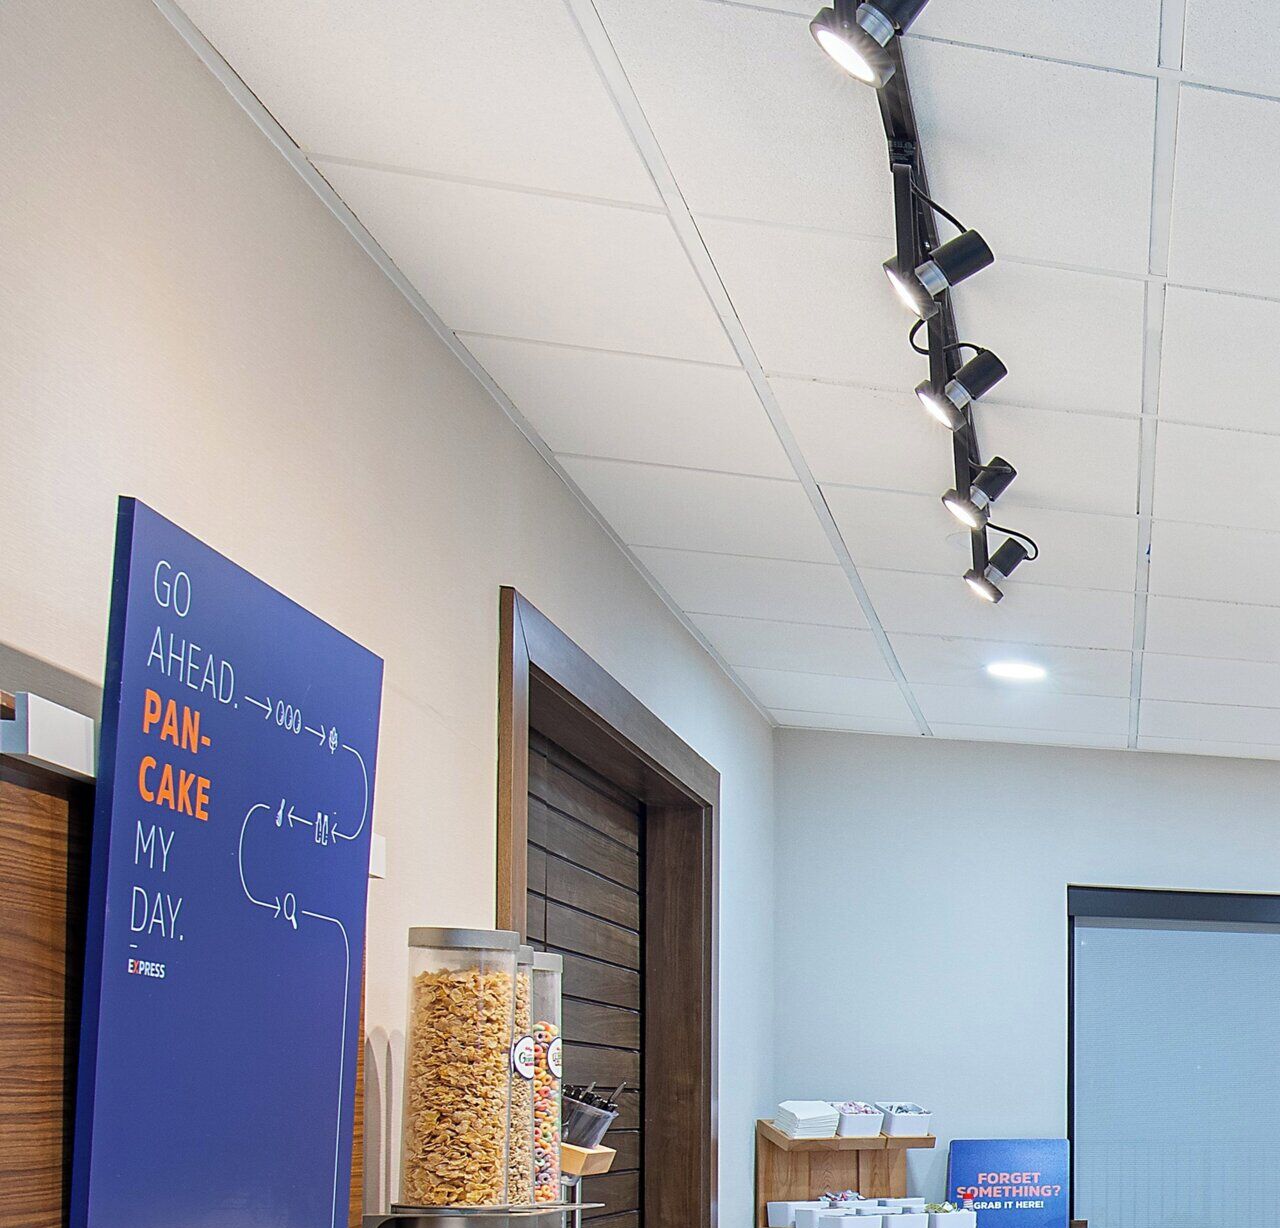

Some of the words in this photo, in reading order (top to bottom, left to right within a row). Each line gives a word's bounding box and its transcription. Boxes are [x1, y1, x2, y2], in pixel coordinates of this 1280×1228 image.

[154, 560, 191, 617] GO
[147, 626, 238, 709] AHEAD.
[143, 688, 211, 754] PAN-
[138, 756, 211, 821] CAKE
[135, 820, 175, 872] MY
[130, 886, 183, 940] DAY.
[128, 958, 165, 978] EXPRESS
[956, 1185, 1061, 1198] SOMETHING?
[974, 1201, 1002, 1209] GRAB
[1004, 1201, 1013, 1209] IT
[1016, 1200, 1044, 1208] HERE!
[977, 1172, 1040, 1184] FORGET
